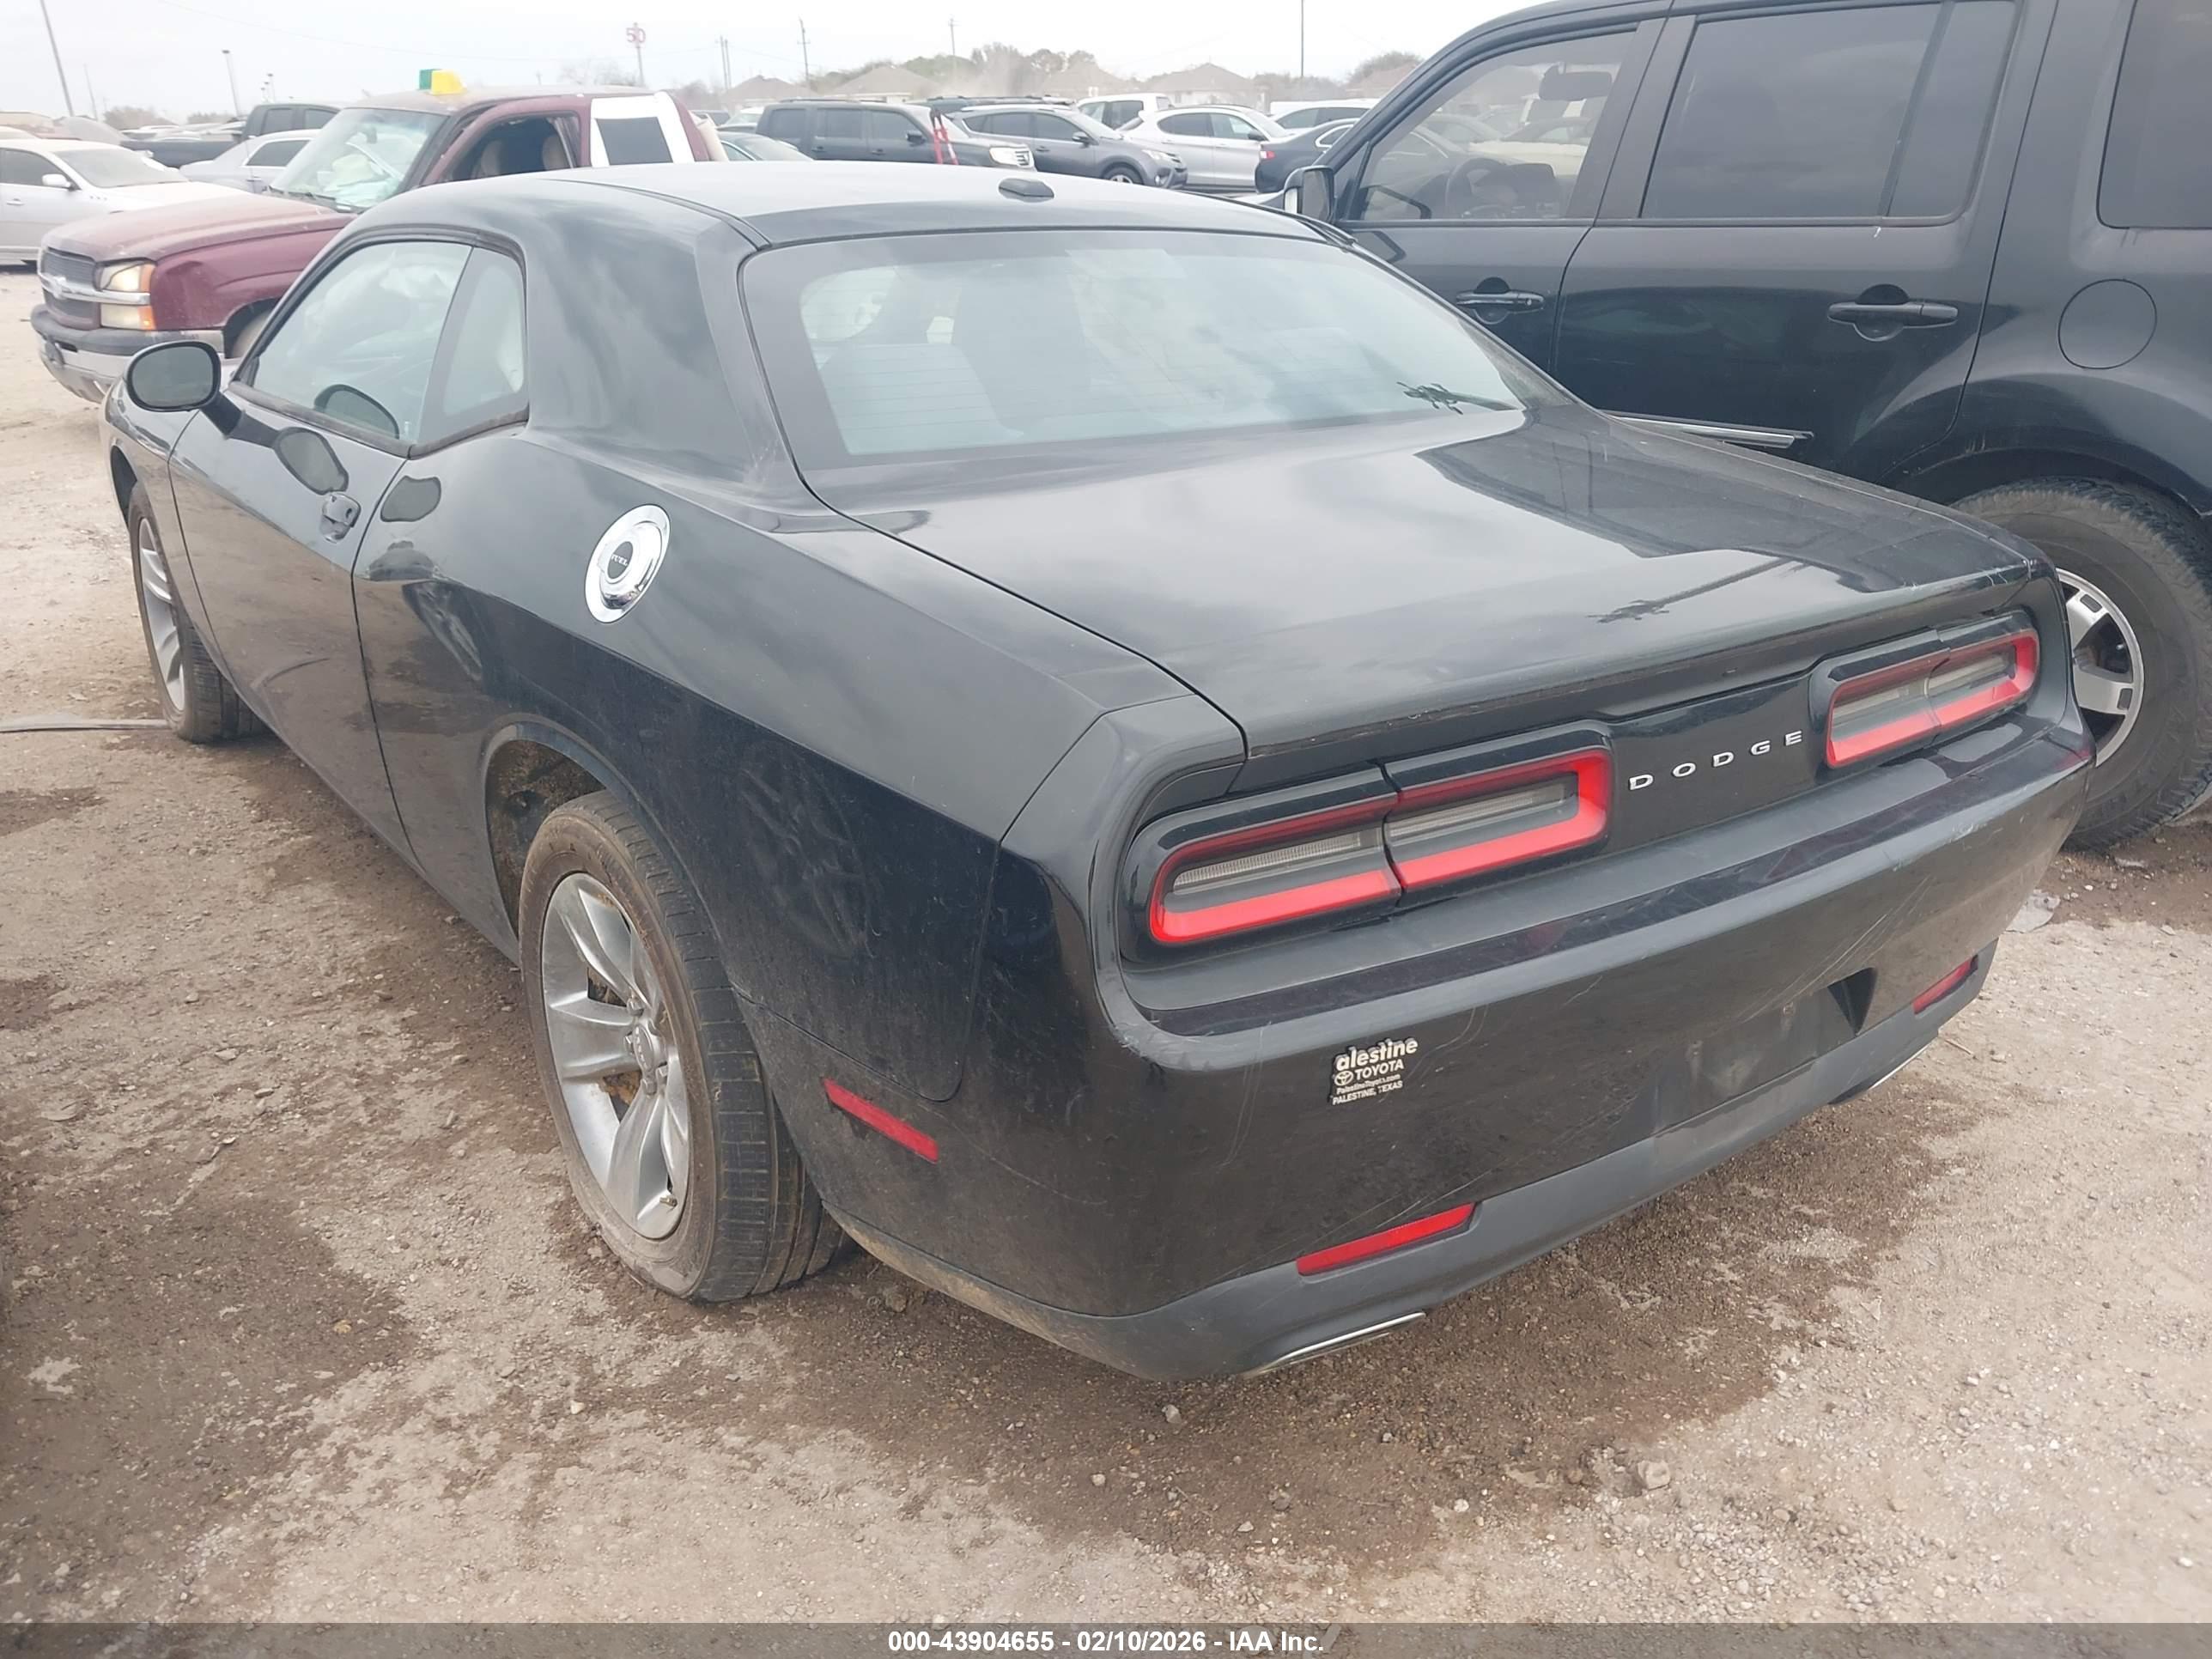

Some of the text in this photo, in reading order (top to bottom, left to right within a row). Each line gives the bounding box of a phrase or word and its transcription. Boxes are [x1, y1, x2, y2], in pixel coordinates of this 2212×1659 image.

[1629, 731, 1802, 790] DODGE
[1355, 1059, 1404, 1080] TOYOTA
[1377, 1080, 1403, 1093] TEXAS
